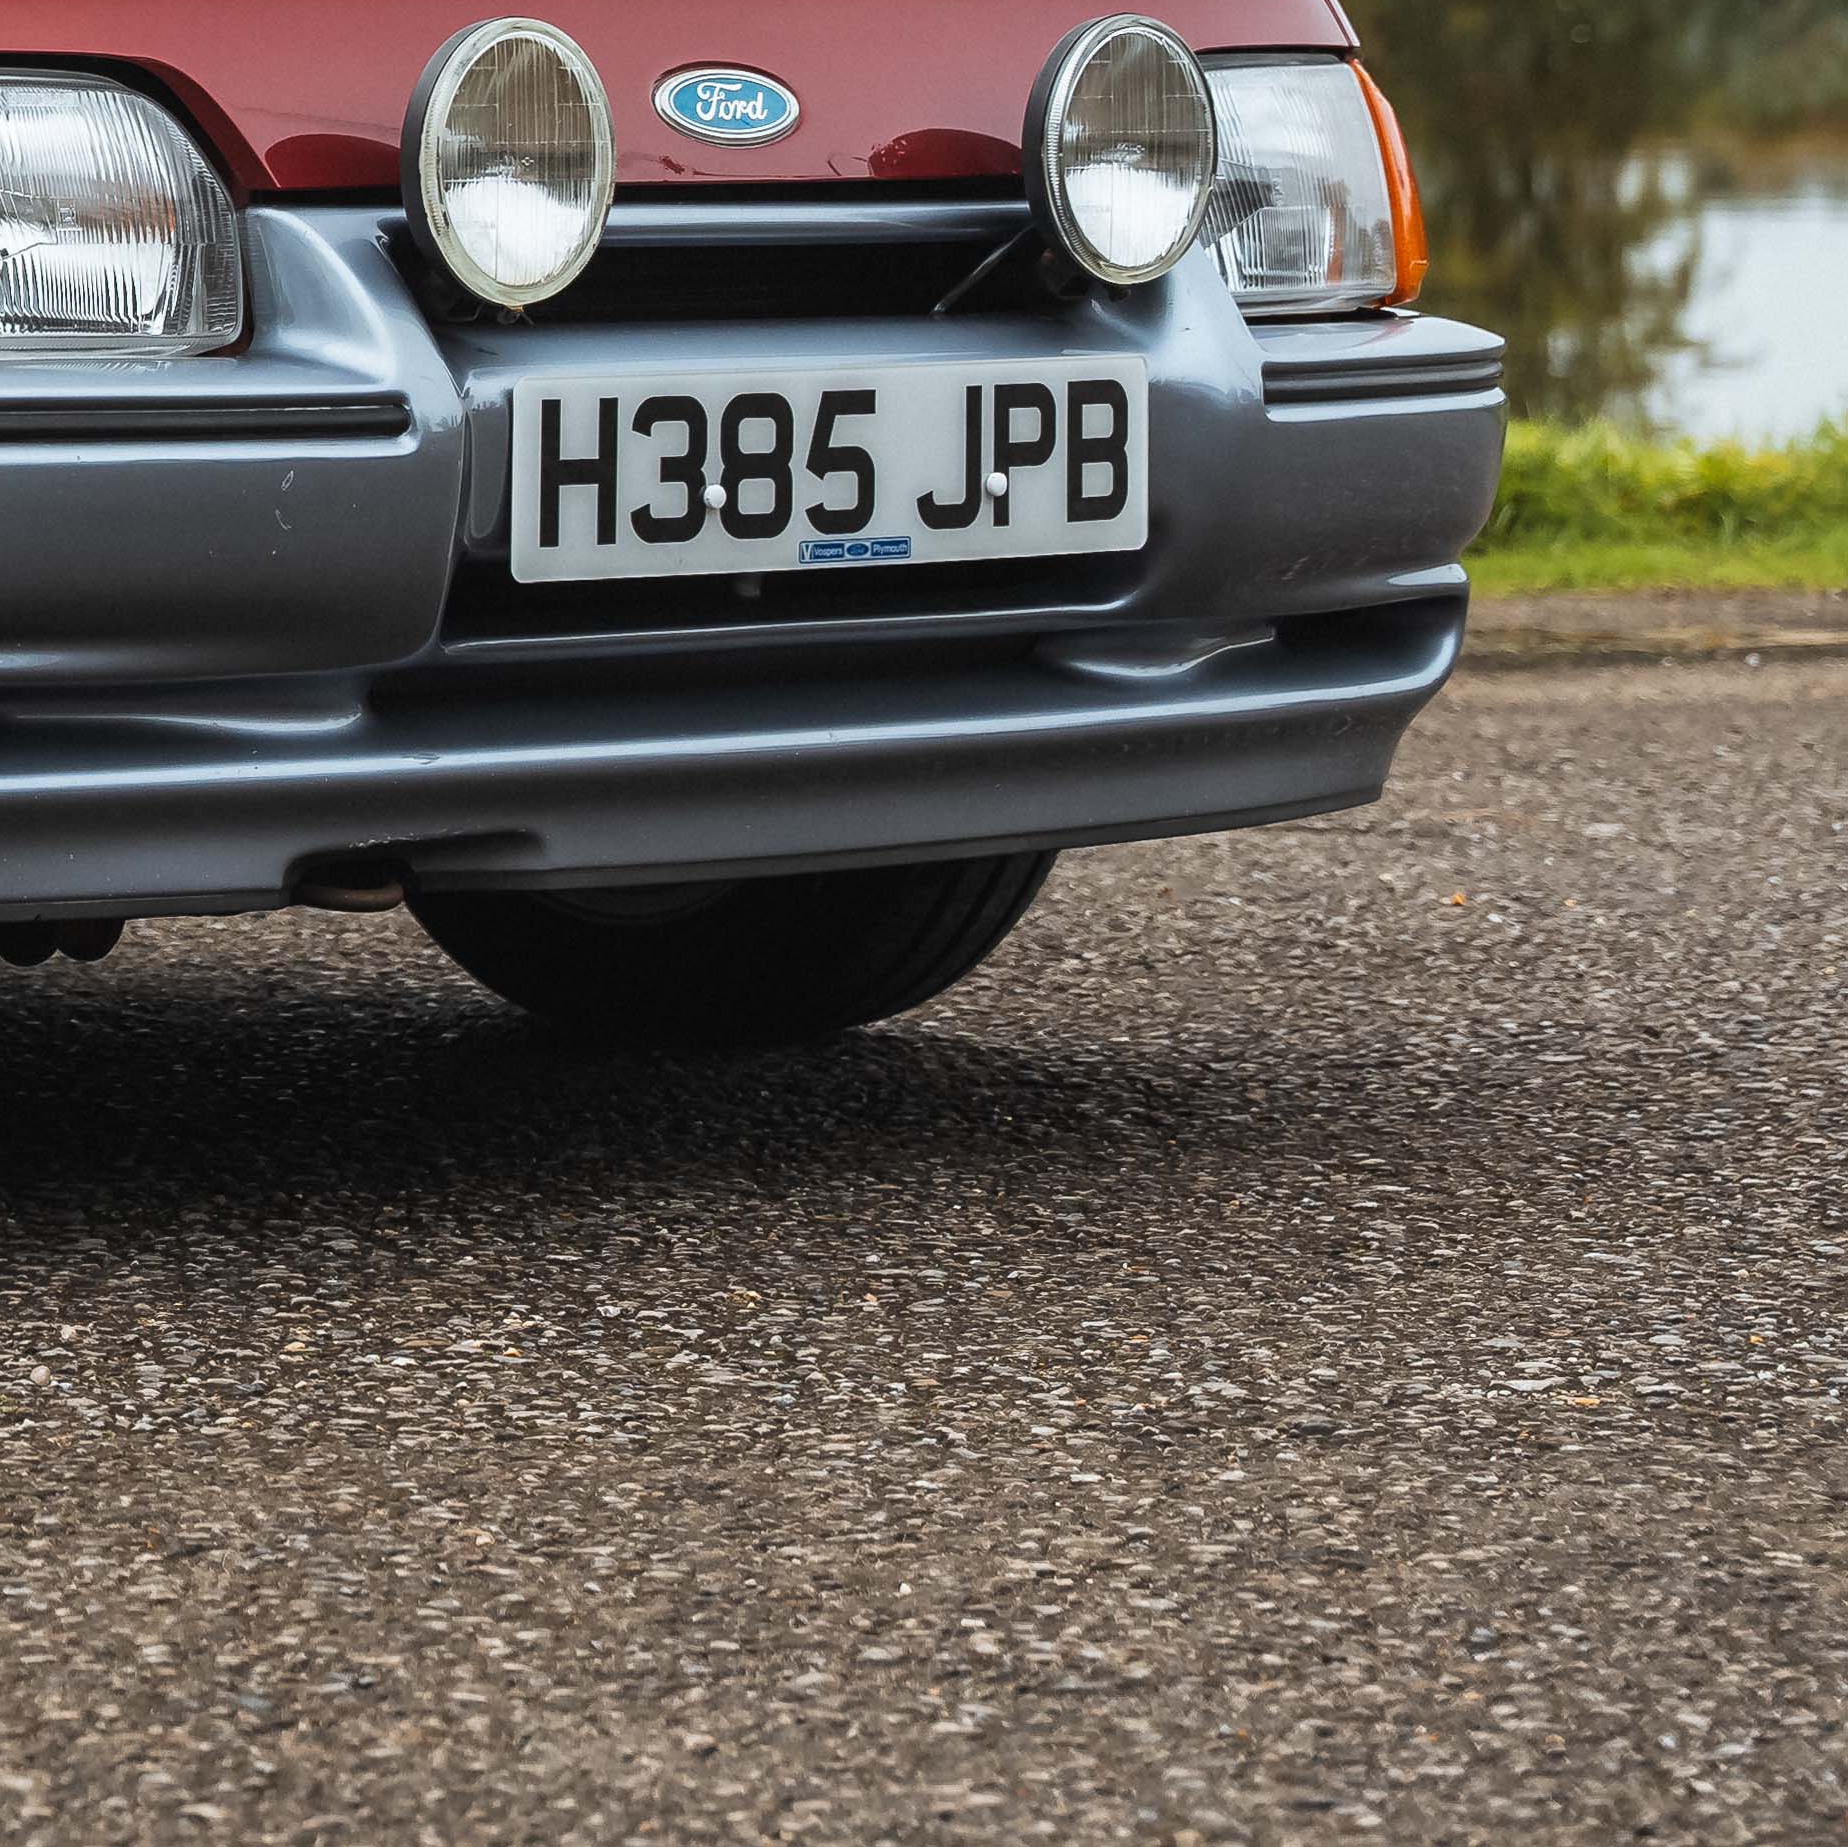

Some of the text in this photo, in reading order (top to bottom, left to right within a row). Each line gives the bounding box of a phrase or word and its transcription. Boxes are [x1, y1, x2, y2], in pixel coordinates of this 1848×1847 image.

[696, 82, 768, 121] Ford
[539, 378, 1128, 549] H385 JPB
[814, 546, 843, 557] Vospers
[873, 543, 908, 554] Plymouth
